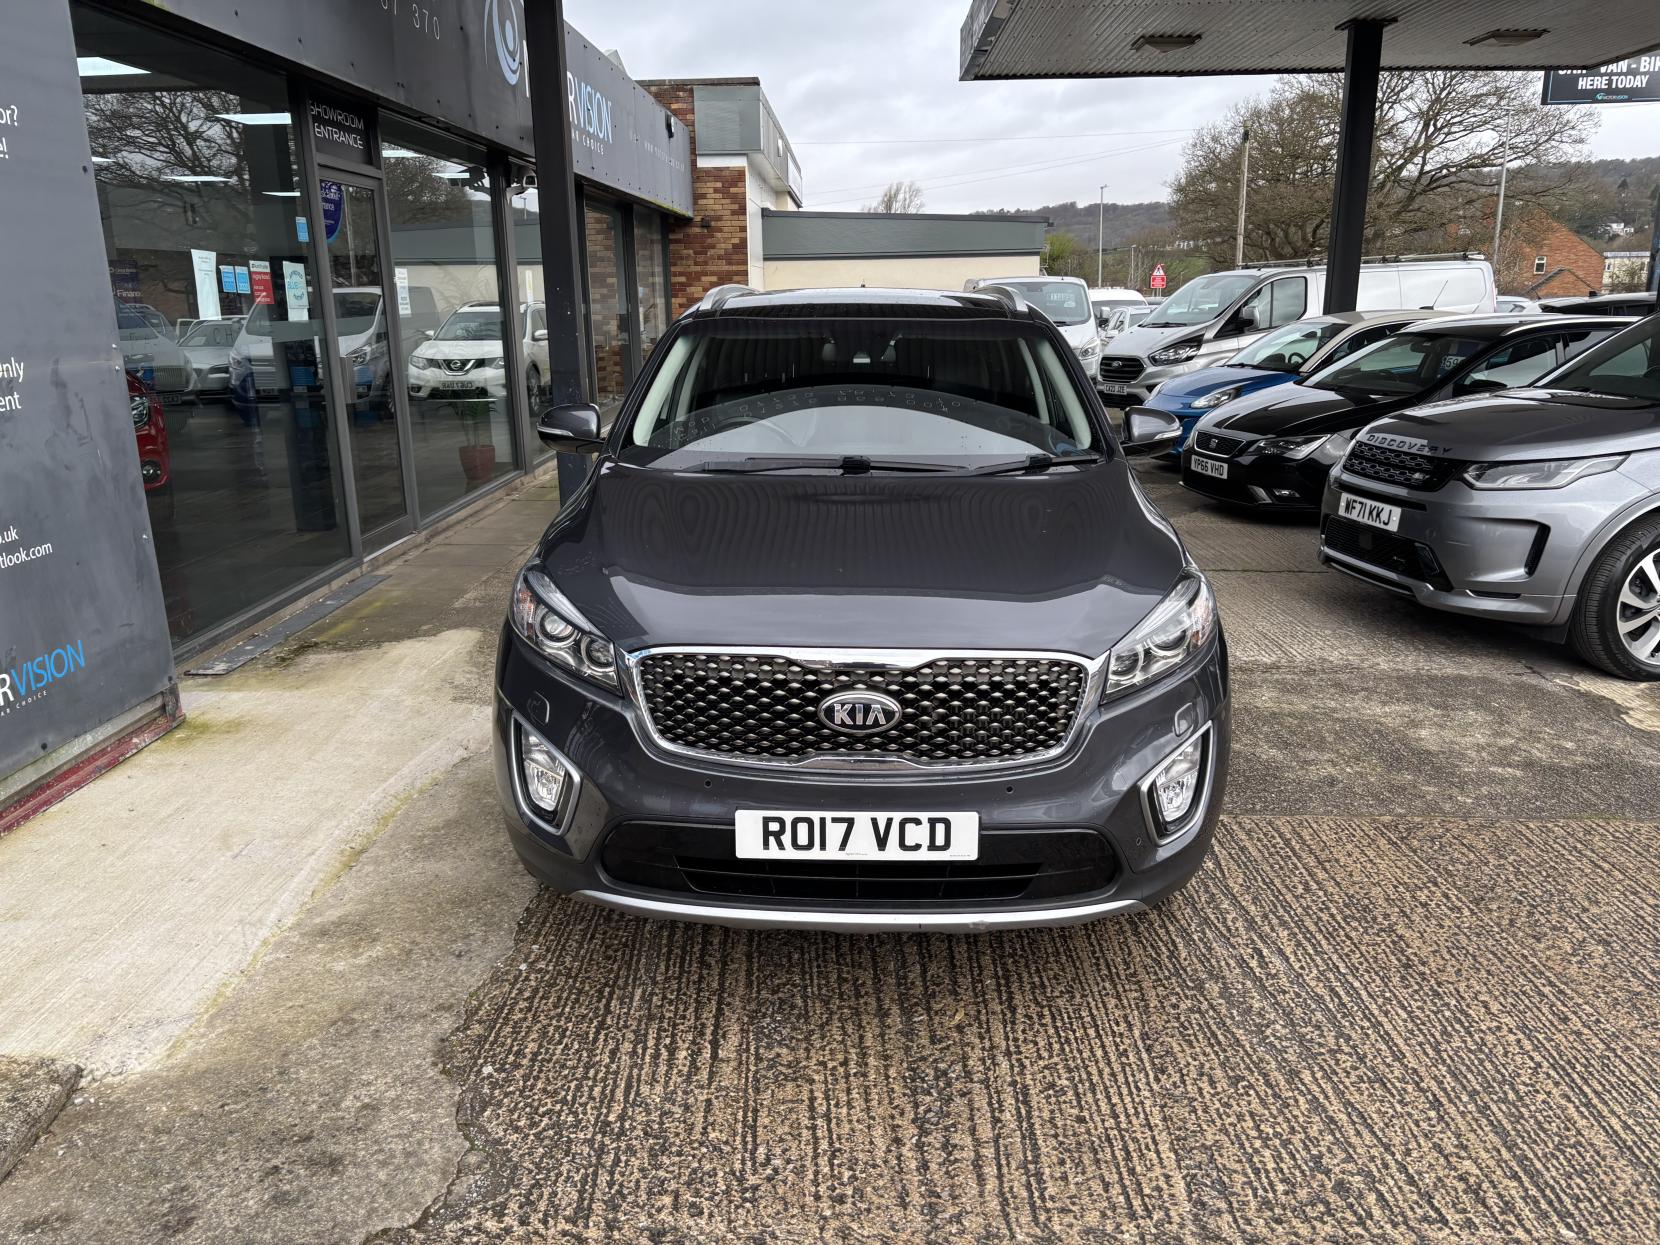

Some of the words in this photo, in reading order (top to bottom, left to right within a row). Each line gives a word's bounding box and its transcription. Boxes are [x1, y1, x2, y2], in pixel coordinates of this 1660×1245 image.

[412, 3, 440, 40] 370
[1578, 76, 1608, 90] HERE
[1611, 75, 1649, 89] TODAY
[314, 122, 364, 149] ENTRANCE
[0, 356, 24, 383] nly
[1366, 434, 1453, 455] DISCOVERY
[1193, 456, 1209, 472] YP66
[1210, 462, 1225, 476] VHD
[1344, 496, 1367, 519] WF71
[1367, 503, 1393, 526] KKJ
[0, 525, 19, 545] .uk
[16, 689, 48, 709] CHOICE
[833, 703, 886, 726] KIA
[761, 816, 856, 851] RO17
[871, 817, 953, 852] VCD
